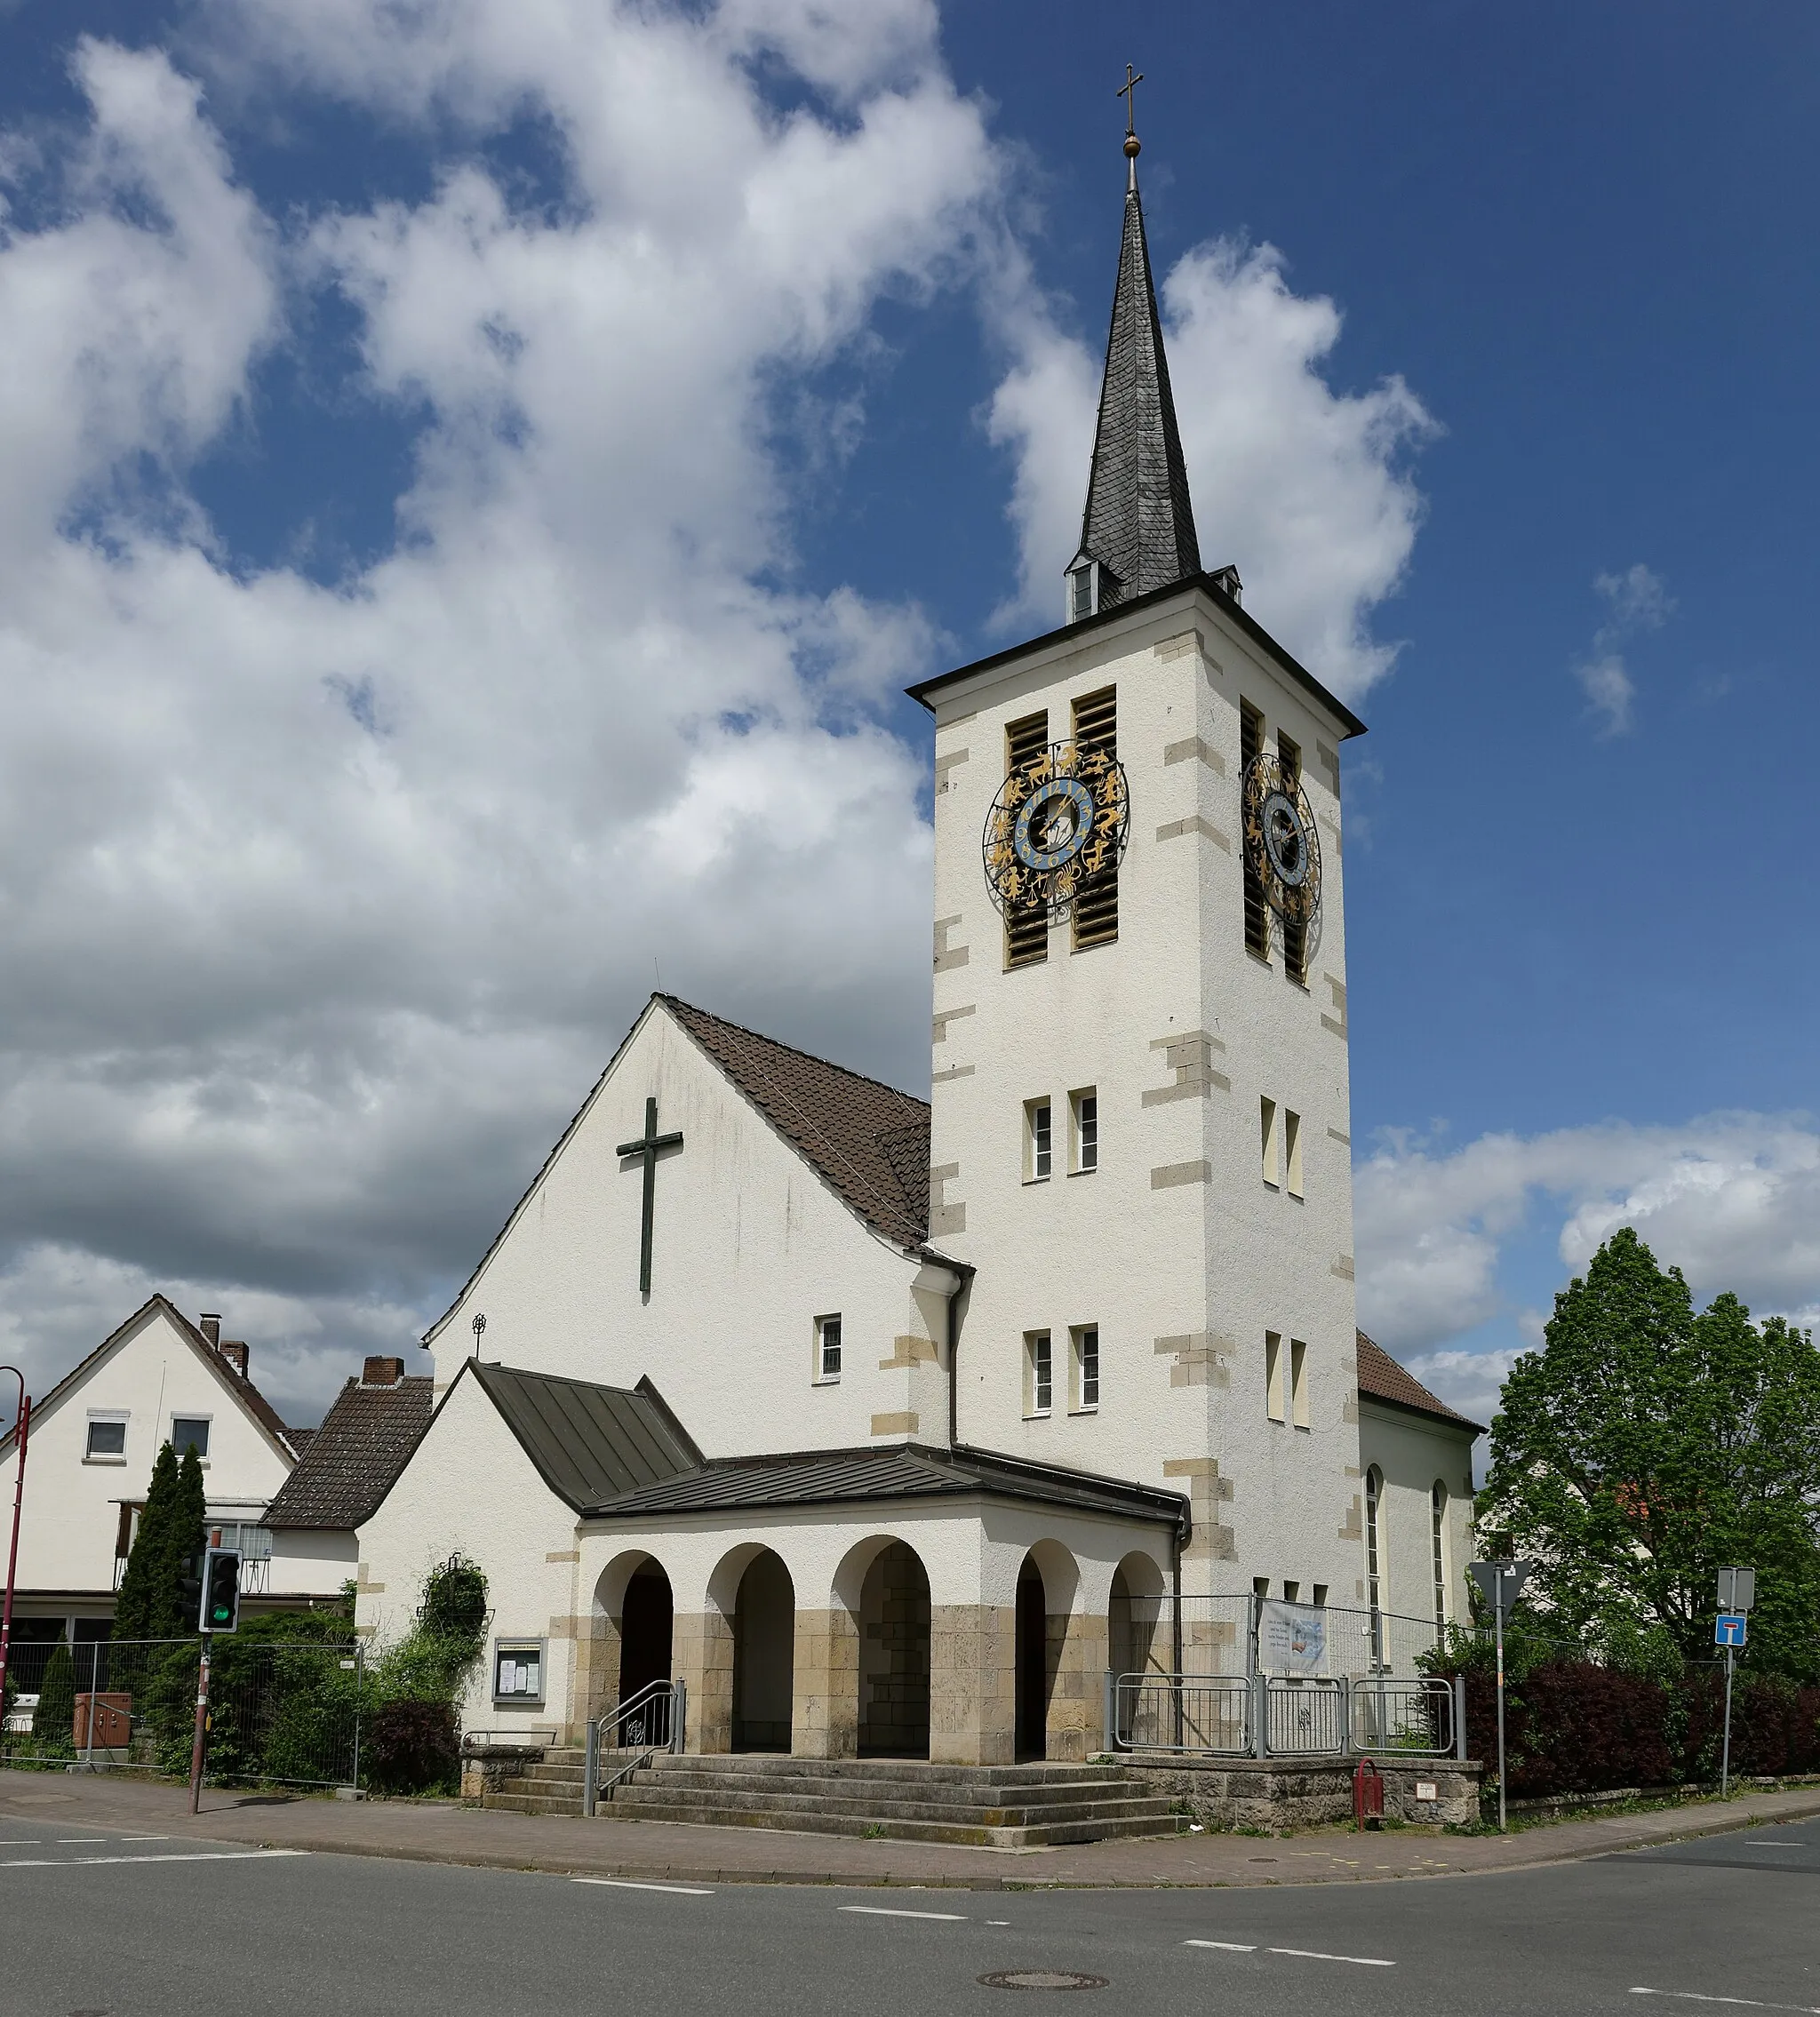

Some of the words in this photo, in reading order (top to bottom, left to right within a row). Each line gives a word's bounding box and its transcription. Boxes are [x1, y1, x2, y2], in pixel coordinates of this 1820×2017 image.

[1047, 779, 1062, 796] 12
[1066, 779, 1073, 796] 1
[1032, 789, 1042, 808] 11
[1020, 807, 1033, 824] 10
[1079, 804, 1092, 822] 3
[1015, 827, 1028, 843] 9
[1021, 841, 1031, 859] 8
[1064, 841, 1076, 860] 5
[1032, 853, 1043, 868] 7
[1047, 851, 1059, 868] 6
